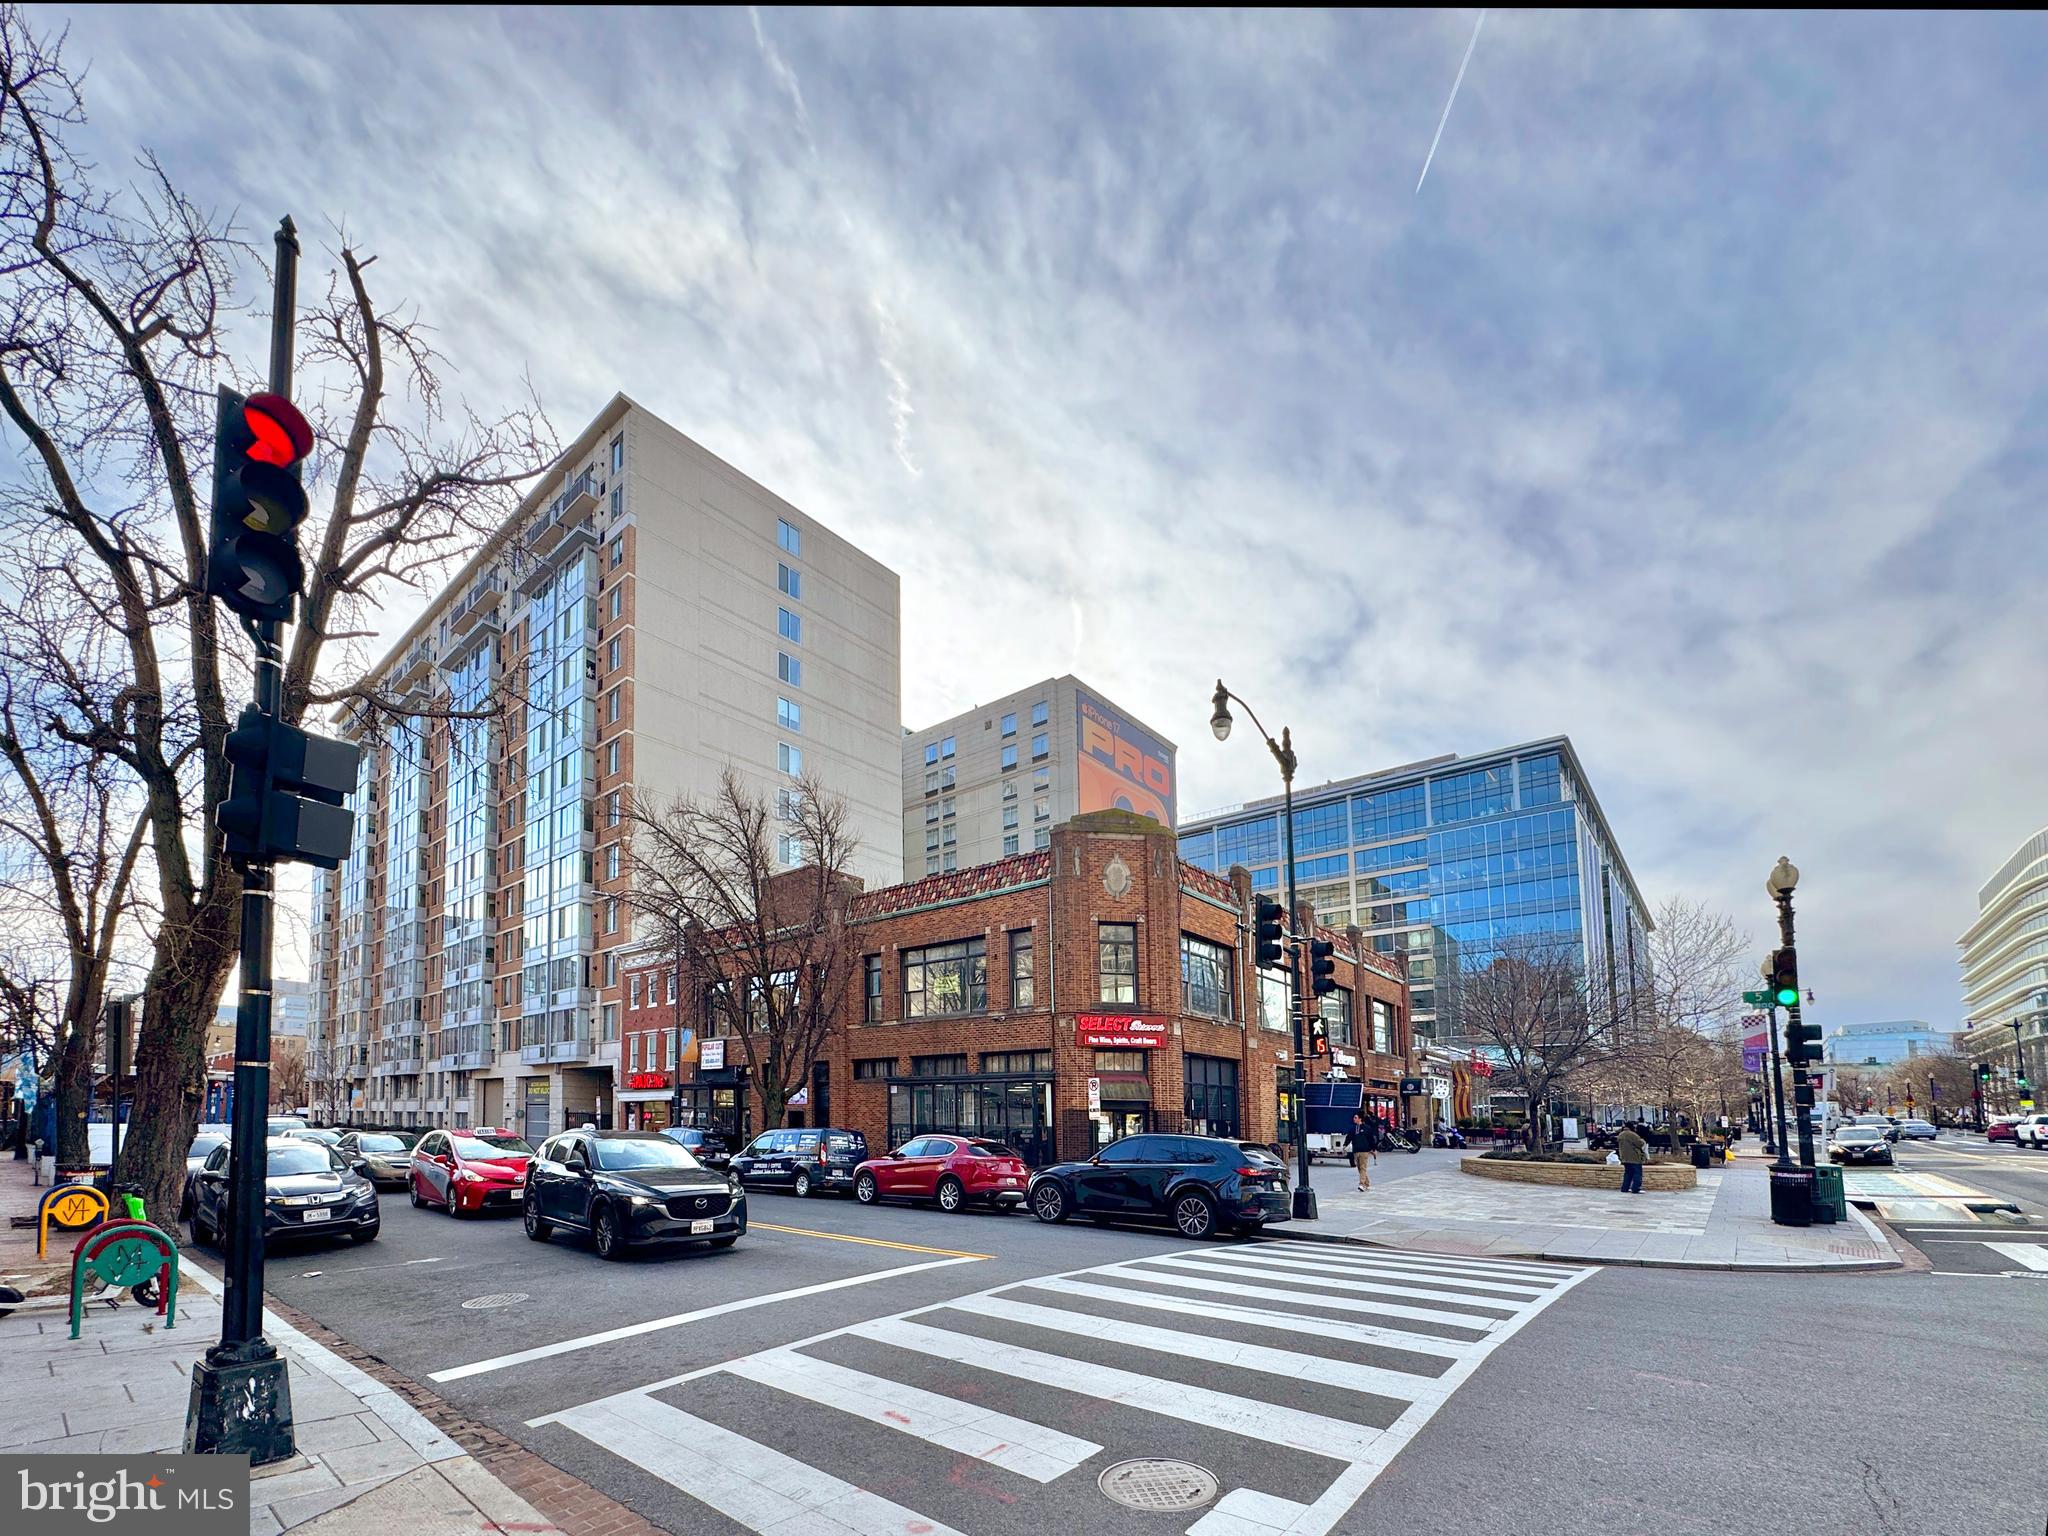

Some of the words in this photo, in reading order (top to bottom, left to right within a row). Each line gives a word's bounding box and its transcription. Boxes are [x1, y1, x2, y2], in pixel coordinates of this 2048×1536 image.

[1082, 716, 1169, 797] PRO
[1080, 1016, 1132, 1031] SELECT
[1316, 1038, 1326, 1053] 15
